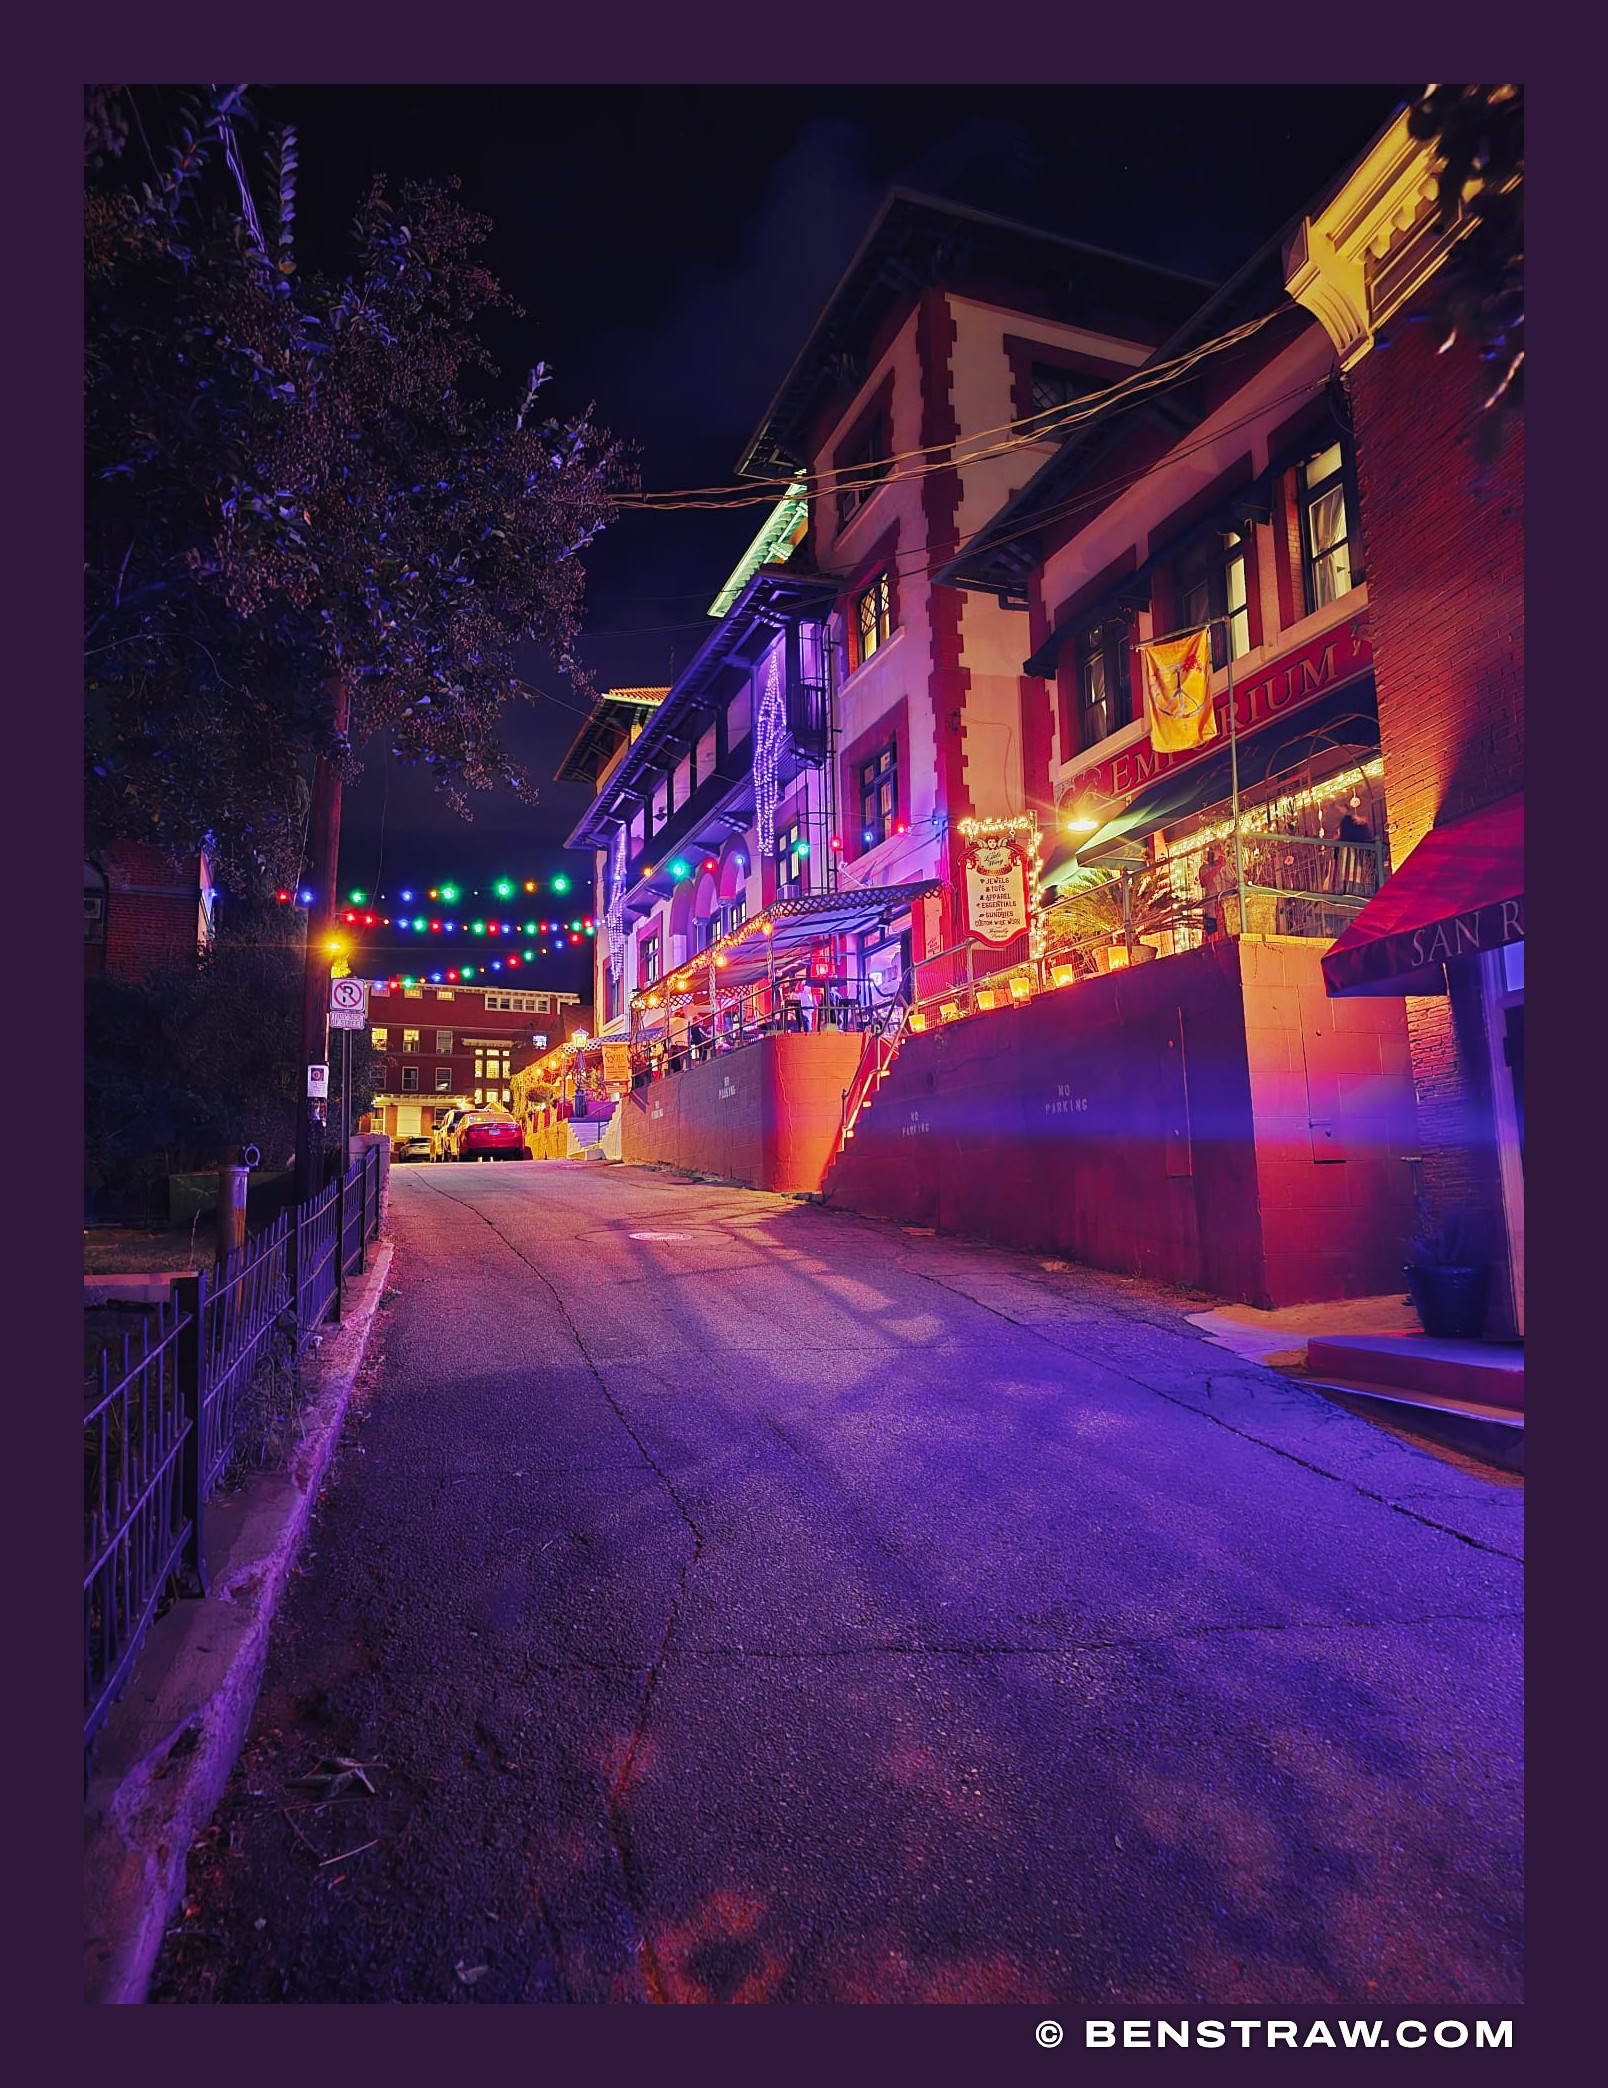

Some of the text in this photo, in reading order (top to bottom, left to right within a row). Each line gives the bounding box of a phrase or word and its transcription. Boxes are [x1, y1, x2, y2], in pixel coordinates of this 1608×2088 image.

[1111, 643, 1338, 795] EMRIUM
[1411, 910, 1481, 966] SAN
[1045, 1098, 1087, 1112] PARKING
[1058, 1084, 1070, 1096] NO
